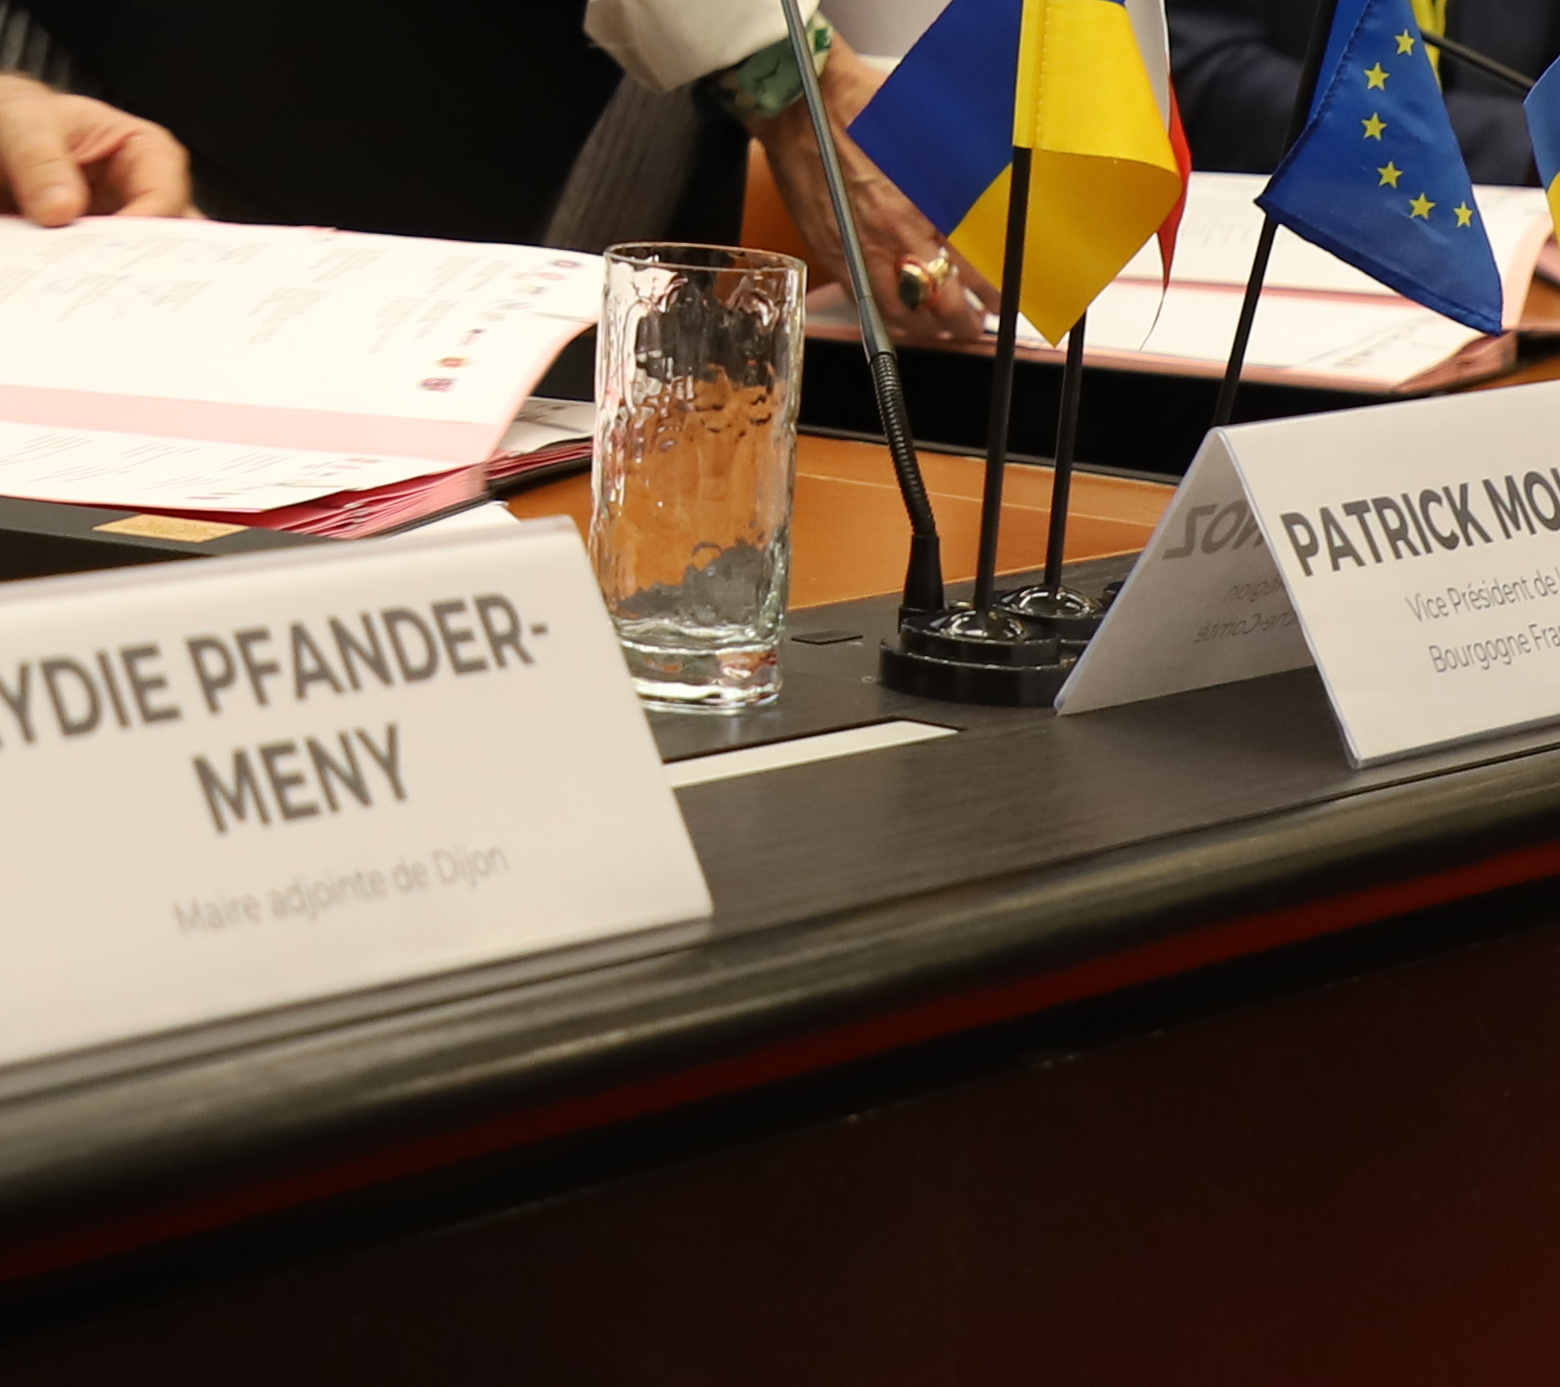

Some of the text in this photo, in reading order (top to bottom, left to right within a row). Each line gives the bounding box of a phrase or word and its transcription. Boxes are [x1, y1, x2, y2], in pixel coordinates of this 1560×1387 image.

[1280, 477, 1482, 579] PATRICK
[1404, 589, 1447, 623] Vice
[1447, 571, 1532, 617] Président
[1533, 567, 1556, 597] de
[186, 589, 552, 716] PFANDER-
[1427, 629, 1532, 675] Bourgogne
[191, 722, 411, 836] MENY
[171, 839, 512, 939] Maire adjointe de Dijon
